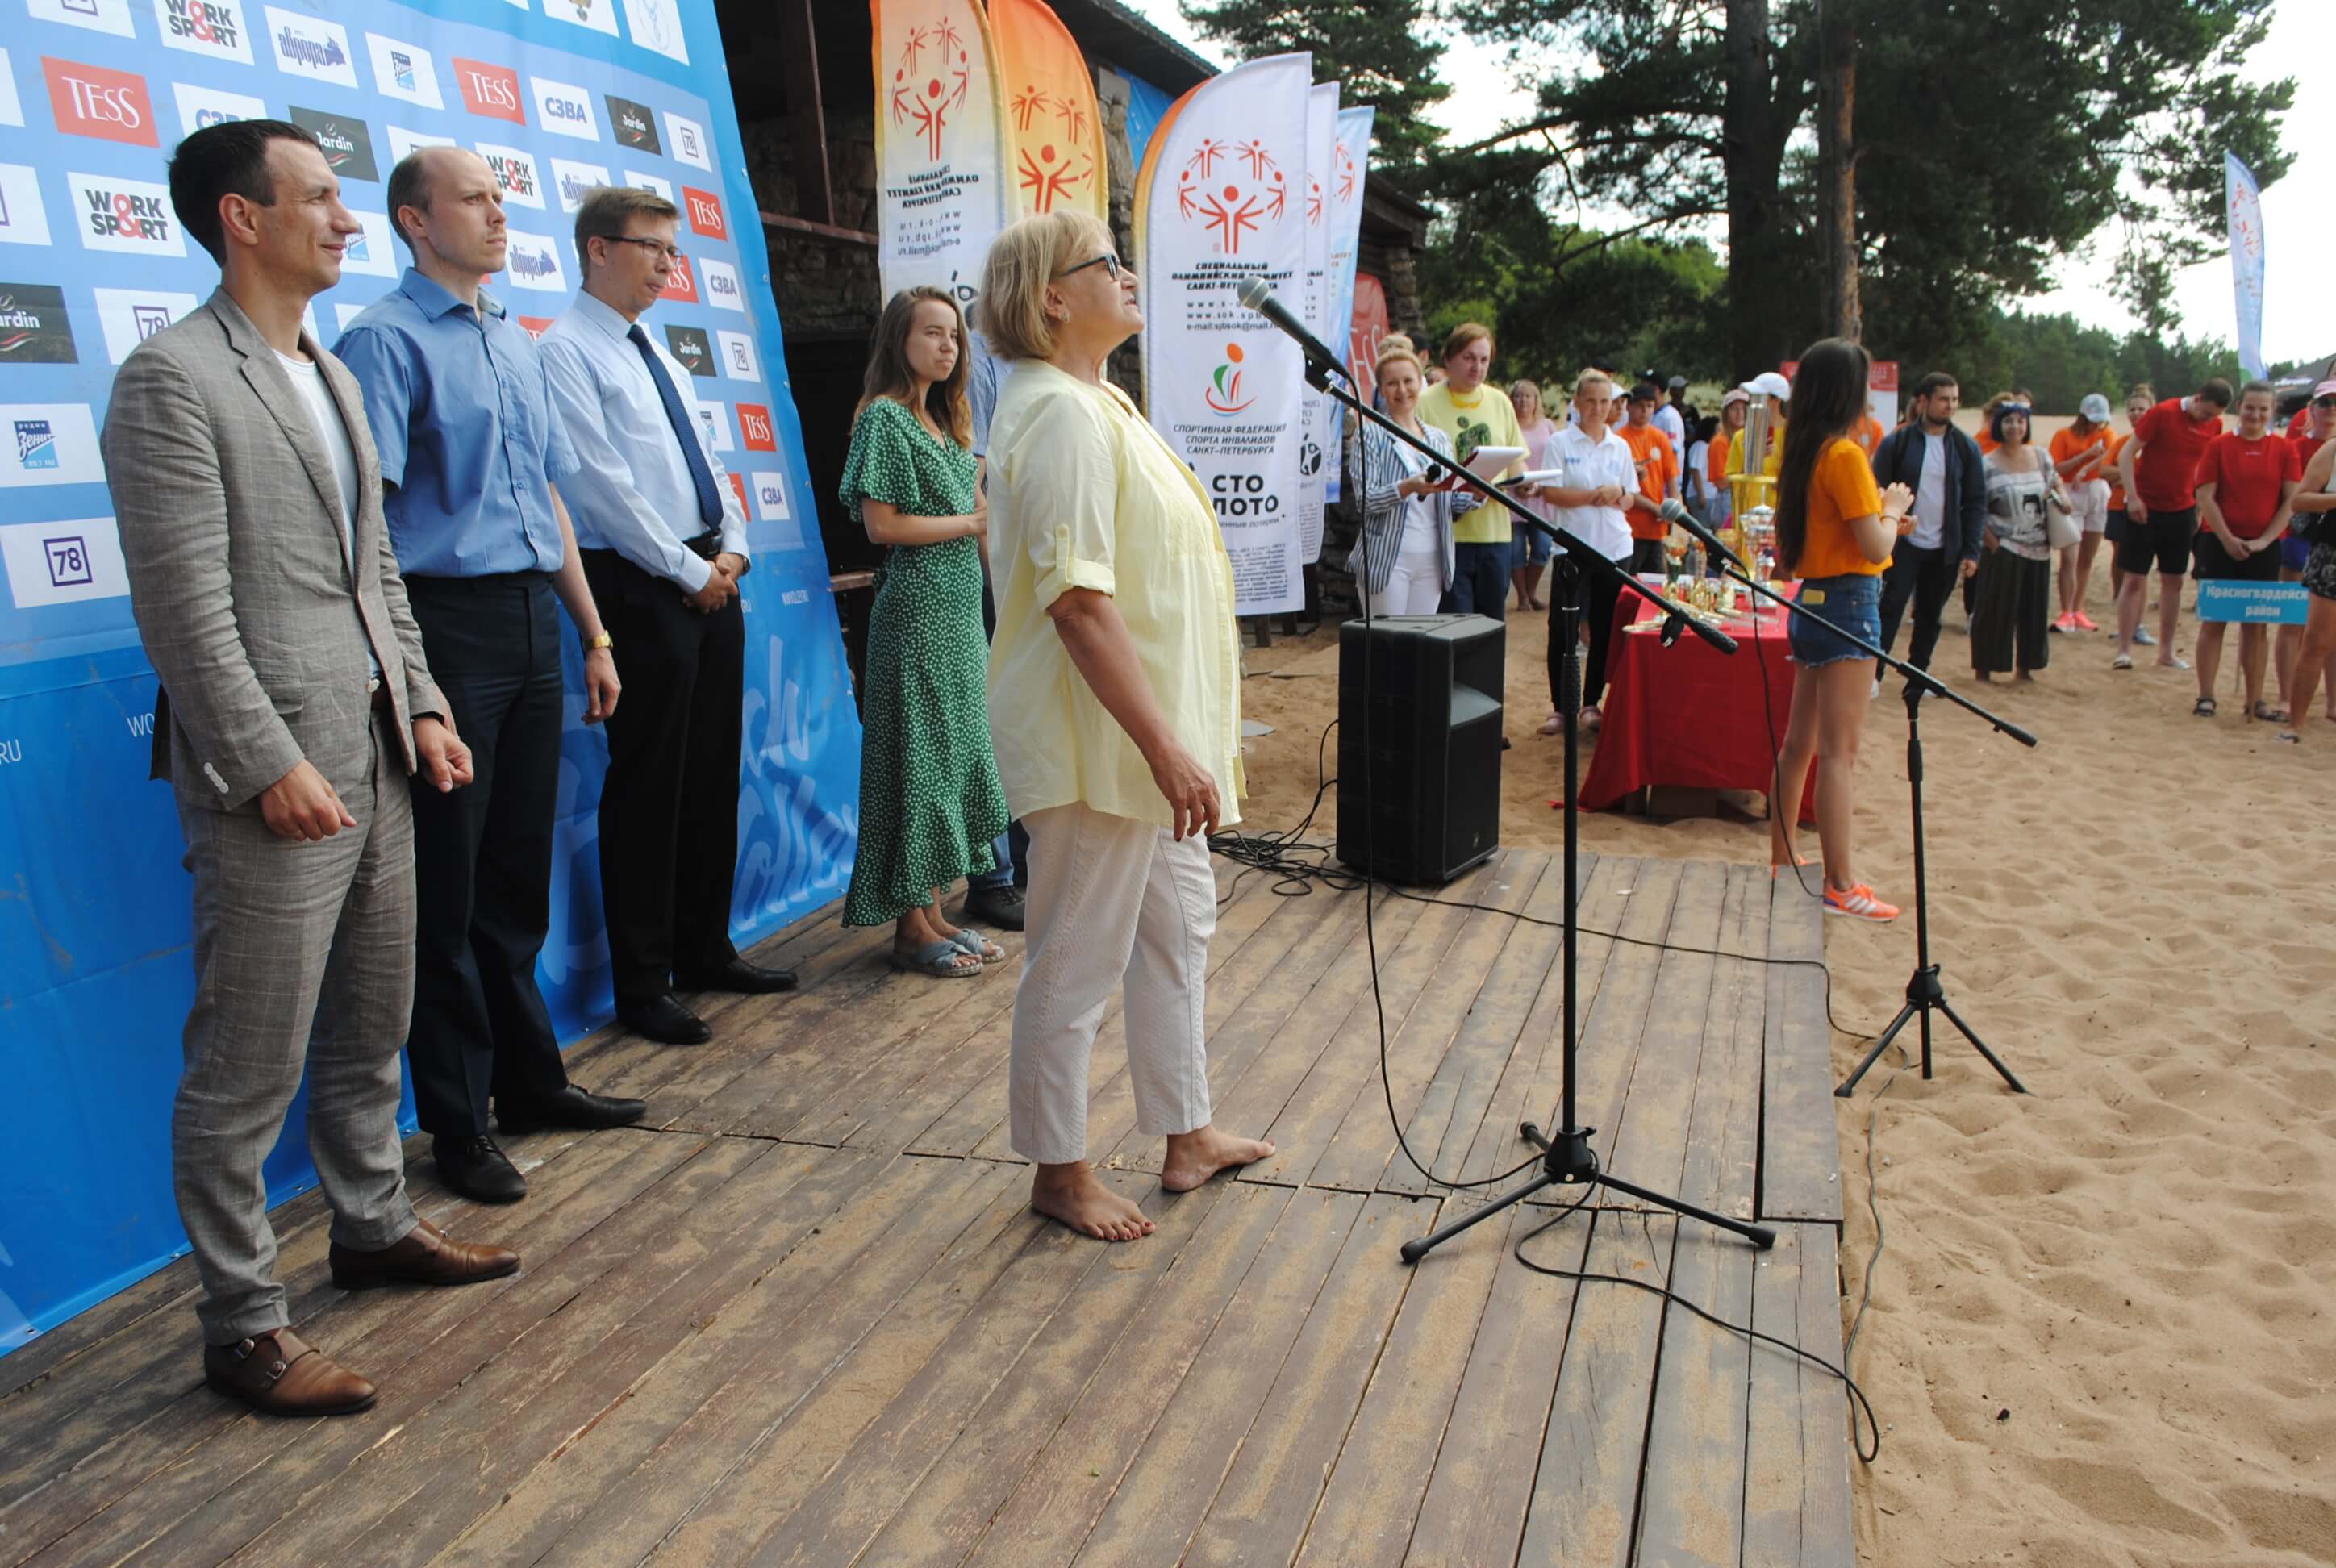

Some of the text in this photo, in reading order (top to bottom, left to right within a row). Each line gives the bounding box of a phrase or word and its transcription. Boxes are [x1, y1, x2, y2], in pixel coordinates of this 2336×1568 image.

[465, 71, 516, 111] TESS
[61, 77, 140, 128] TESS
[316, 131, 354, 152] Jardin
[690, 197, 722, 231] TESS
[1172, 271, 1293, 280] ОЛИМПИЙСКИЙ МИТЕТ
[1195, 262, 1268, 272] СПЕЦИАЛЬНЫЙ
[743, 413, 770, 442] TESS
[1174, 423, 1287, 433] СПОРТИВНАЯ ФЕДЕРАЦИЯ
[1185, 435, 1276, 444] СПОРТА ИНВАЛИДОВ
[1212, 474, 1264, 493] СТО
[53, 547, 82, 576] 78
[2245, 606, 2281, 618] район
